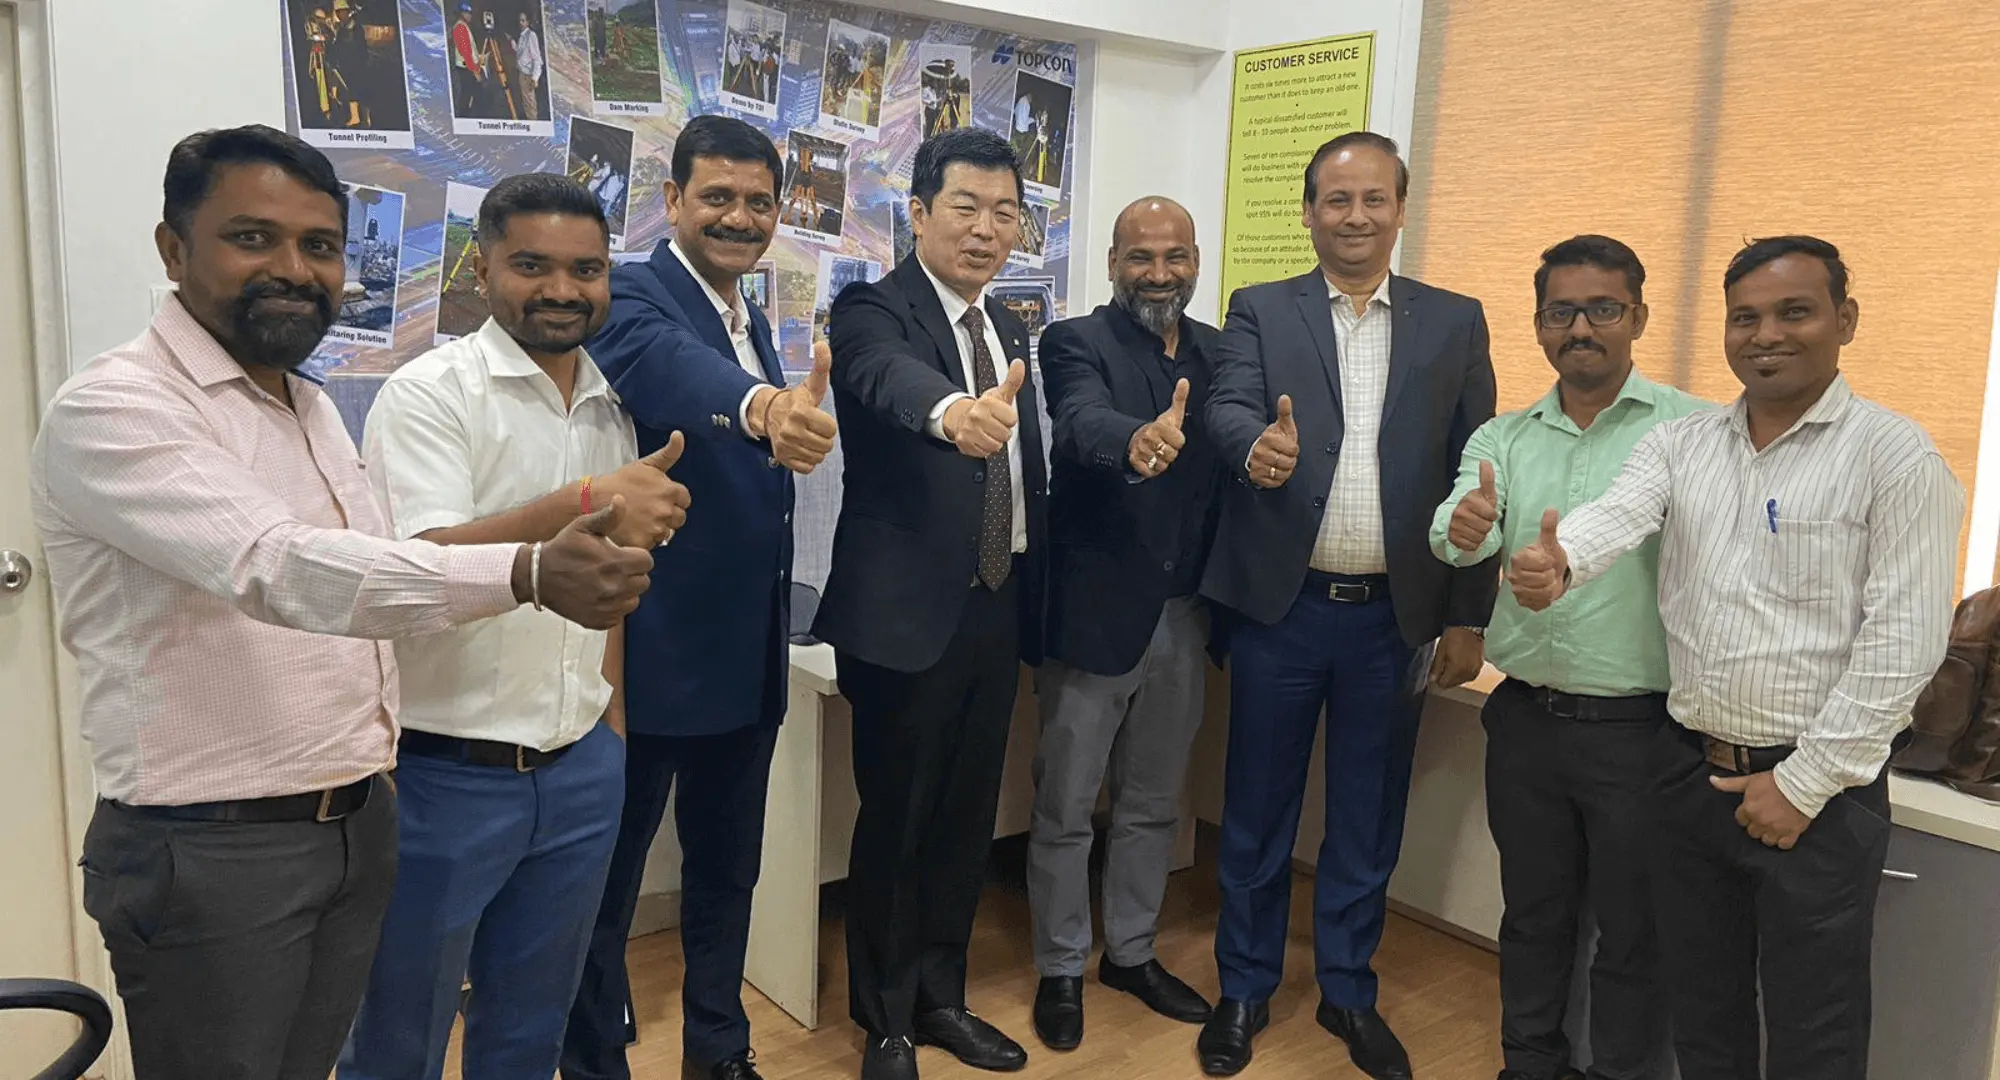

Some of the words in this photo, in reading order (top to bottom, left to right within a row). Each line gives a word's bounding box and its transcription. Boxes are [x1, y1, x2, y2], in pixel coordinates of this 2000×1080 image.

[1015, 50, 1072, 74] TOPCON
[1244, 54, 1305, 74] CUSTOMER
[1308, 46, 1360, 65] SERVICE
[1274, 79, 1290, 87] times
[1291, 77, 1307, 85] more
[1316, 73, 1336, 82] attract
[1240, 94, 1267, 103] customer
[1267, 91, 1280, 100] than
[1287, 89, 1301, 98] does
[1302, 88, 1309, 96] to
[1310, 86, 1325, 96] keep
[1335, 83, 1346, 92] old
[1346, 83, 1361, 91] one.
[609, 103, 623, 111] Dam
[624, 103, 649, 113] Marking
[1254, 115, 1273, 125] typical
[1274, 112, 1306, 123] dissatisfied
[1306, 110, 1335, 120] customer
[1336, 108, 1348, 116] will
[478, 121, 501, 130] Tunnel
[503, 122, 531, 132] Profiling
[1269, 126, 1289, 136] people
[1290, 124, 1308, 133] about
[1308, 123, 1323, 132] their
[328, 133, 354, 142] Tunnel
[356, 133, 388, 144] Profiling
[1243, 152, 1261, 160] Seven
[1261, 151, 1269, 159] of
[1241, 164, 1251, 172] will
[1252, 163, 1260, 171] do
[1261, 162, 1285, 171] business
[1286, 161, 1300, 170] with
[1242, 175, 1266, 183] resolve
[1266, 175, 1275, 183] the
[1250, 200, 1261, 208] you
[1262, 198, 1282, 207] resolve
[1245, 211, 1258, 219] spot
[1240, 245, 1262, 253] because
[1263, 245, 1271, 253] of
[1279, 245, 1302, 253] attitude
[1303, 244, 1310, 252] of
[1233, 257, 1241, 265] by
[1289, 256, 1312, 265] specific
[357, 332, 387, 344] Solution
